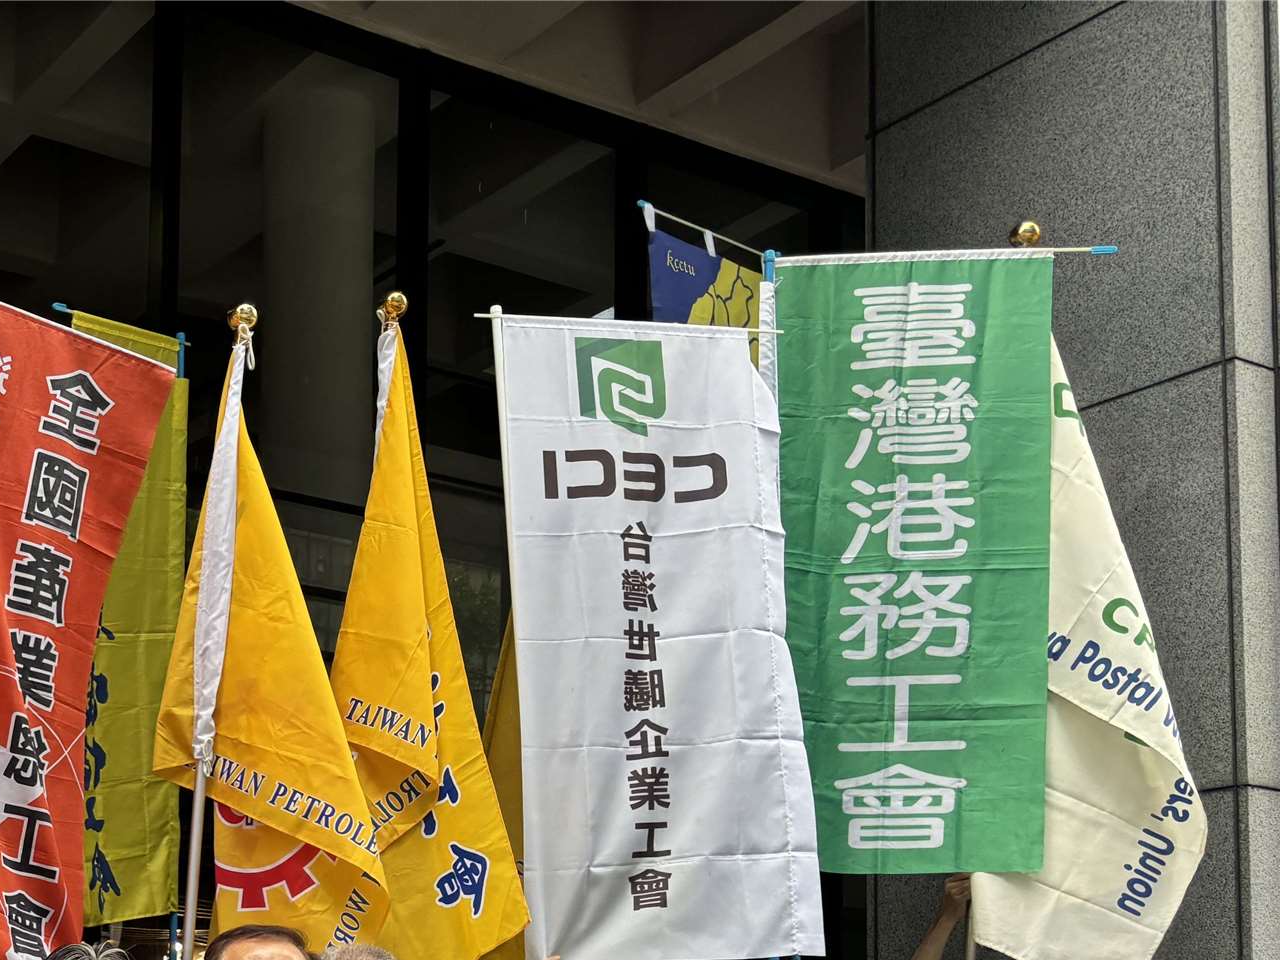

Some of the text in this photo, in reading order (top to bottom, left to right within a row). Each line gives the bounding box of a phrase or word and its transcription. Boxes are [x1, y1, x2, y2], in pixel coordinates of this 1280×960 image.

[834, 281, 978, 849] 臺灣港務工會
[1070, 639, 1163, 712] Postal
[346, 697, 433, 749] TAIWAN
[184, 752, 267, 797] IWAN
